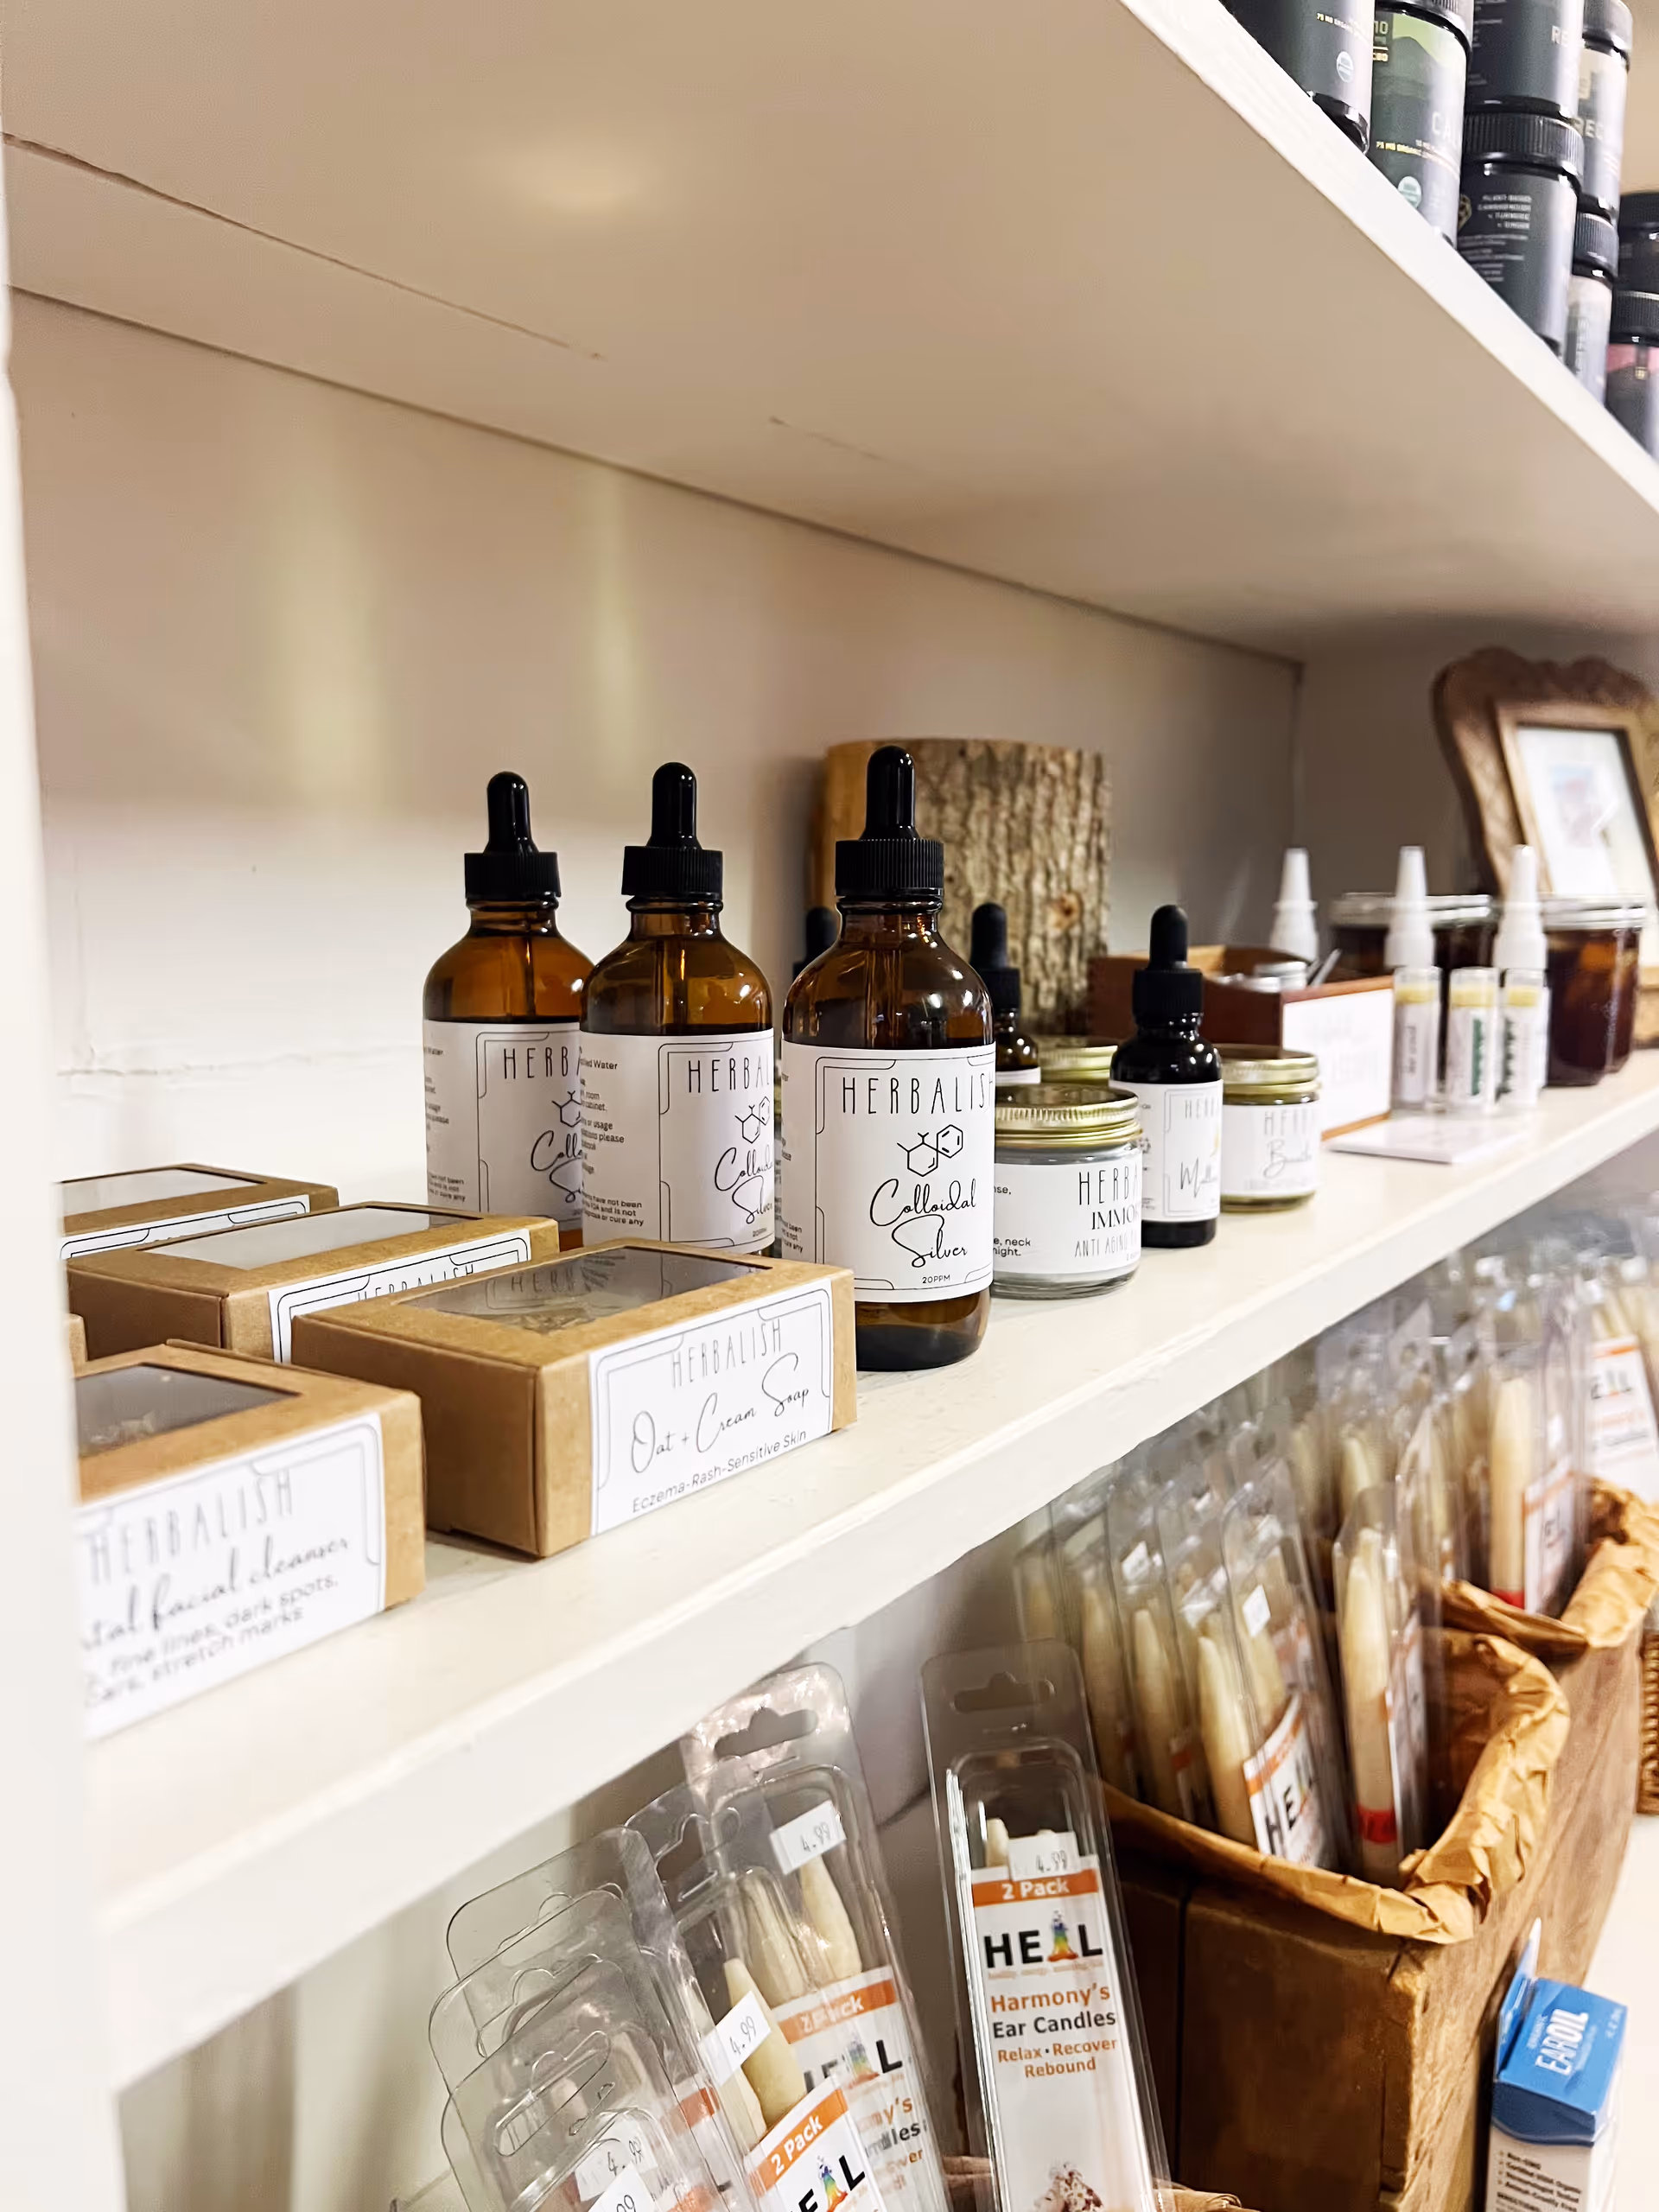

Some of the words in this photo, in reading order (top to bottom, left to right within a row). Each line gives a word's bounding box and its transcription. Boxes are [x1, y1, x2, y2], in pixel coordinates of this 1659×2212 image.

[594, 1059, 618, 1070] Water
[594, 1121, 613, 1132] usage
[599, 1133, 624, 1143] please
[869, 1178, 976, 1227] Colloidal
[629, 1218, 645, 1227] any
[891, 1213, 968, 1268] Silver
[1005, 1237, 1031, 1247] neck
[1074, 1238, 1100, 1259] ANTI
[921, 1274, 951, 1285] 20PPM
[671, 1319, 781, 1389] HERBALISH
[631, 1410, 676, 1473] Oat
[696, 1392, 757, 1453] Cream
[761, 1351, 810, 1417] Soap
[783, 1430, 807, 1450] Skin
[152, 1547, 238, 1631] facial
[249, 1534, 349, 1586] cleanser
[225, 1595, 272, 1630] dark
[240, 1607, 304, 1644] marks
[1001, 1883, 1015, 1901] 2
[1020, 1878, 1071, 1898] Pack
[991, 1983, 1111, 2013] Harmony's
[728, 2015, 758, 2056] 4.99
[993, 2020, 1027, 2039] Ear
[1033, 2011, 1116, 2035] Candles
[998, 2044, 1044, 2063] Relax
[1052, 2037, 1117, 2056] Recover
[1025, 2056, 1096, 2079] Rebound
[771, 2153, 785, 2177] 2
[784, 2113, 824, 2162] Pack
